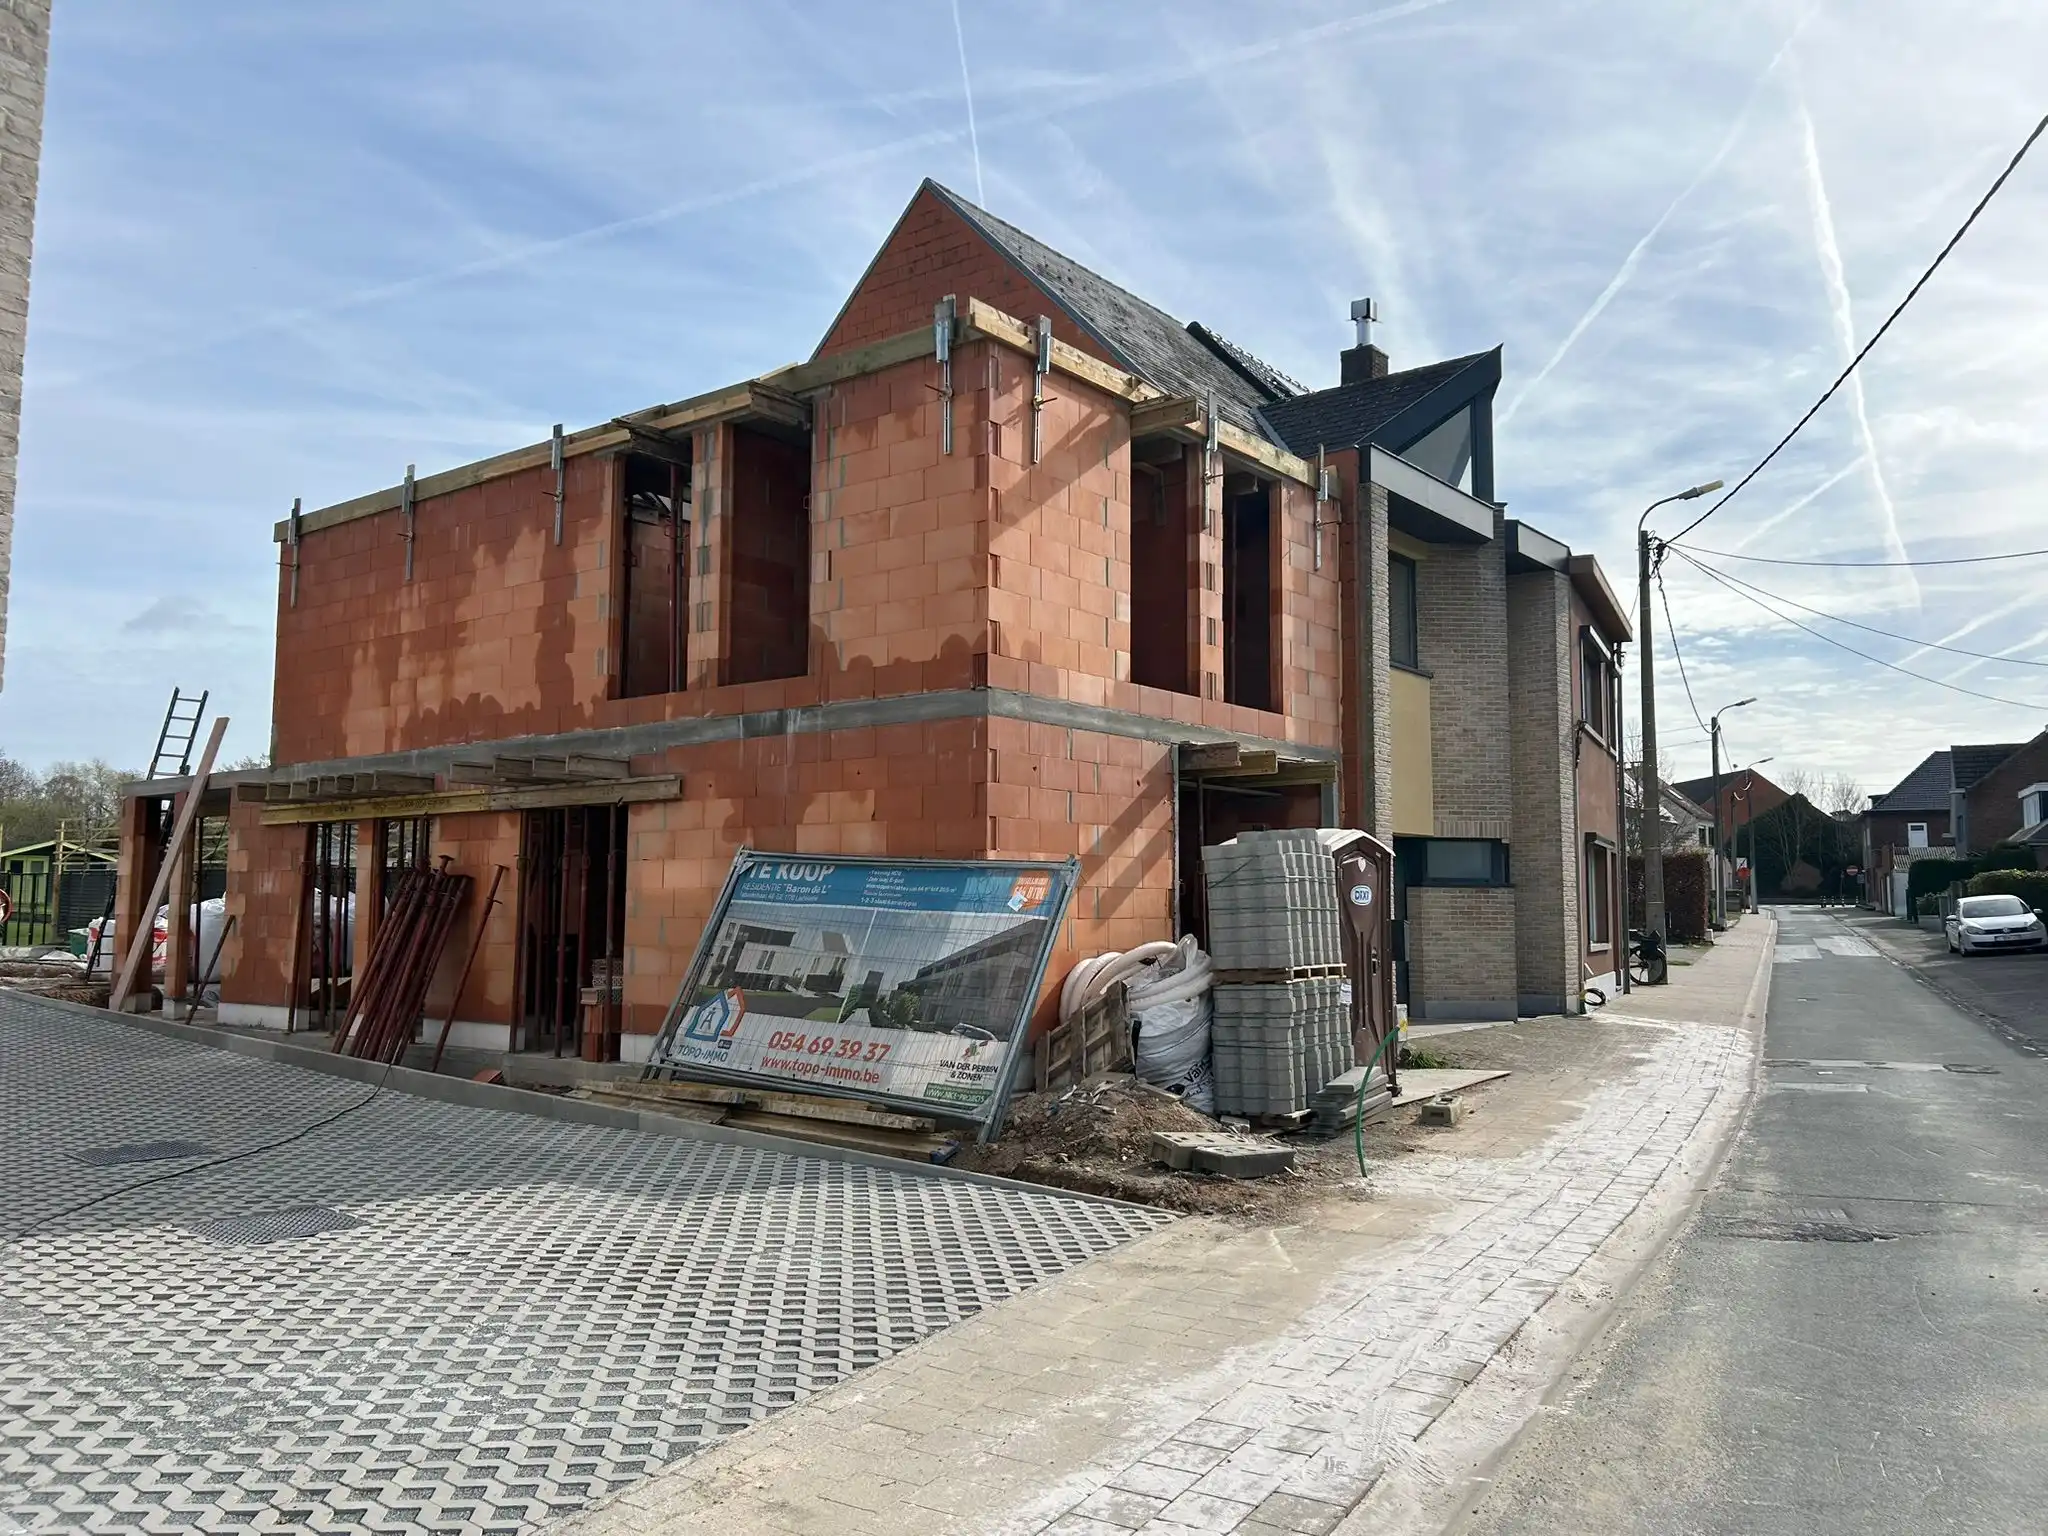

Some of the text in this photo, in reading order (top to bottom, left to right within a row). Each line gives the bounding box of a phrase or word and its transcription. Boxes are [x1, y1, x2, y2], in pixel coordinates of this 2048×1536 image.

[776, 863, 835, 881] KOOP
[679, 1044, 729, 1062] TOPO-IMMO
[768, 1031, 891, 1062] 054 69 39 37
[761, 1056, 880, 1083] www.topo-immo.be
[940, 1060, 956, 1070] VAN
[956, 1062, 971, 1072] DER
[957, 1071, 983, 1081] ZONEN
